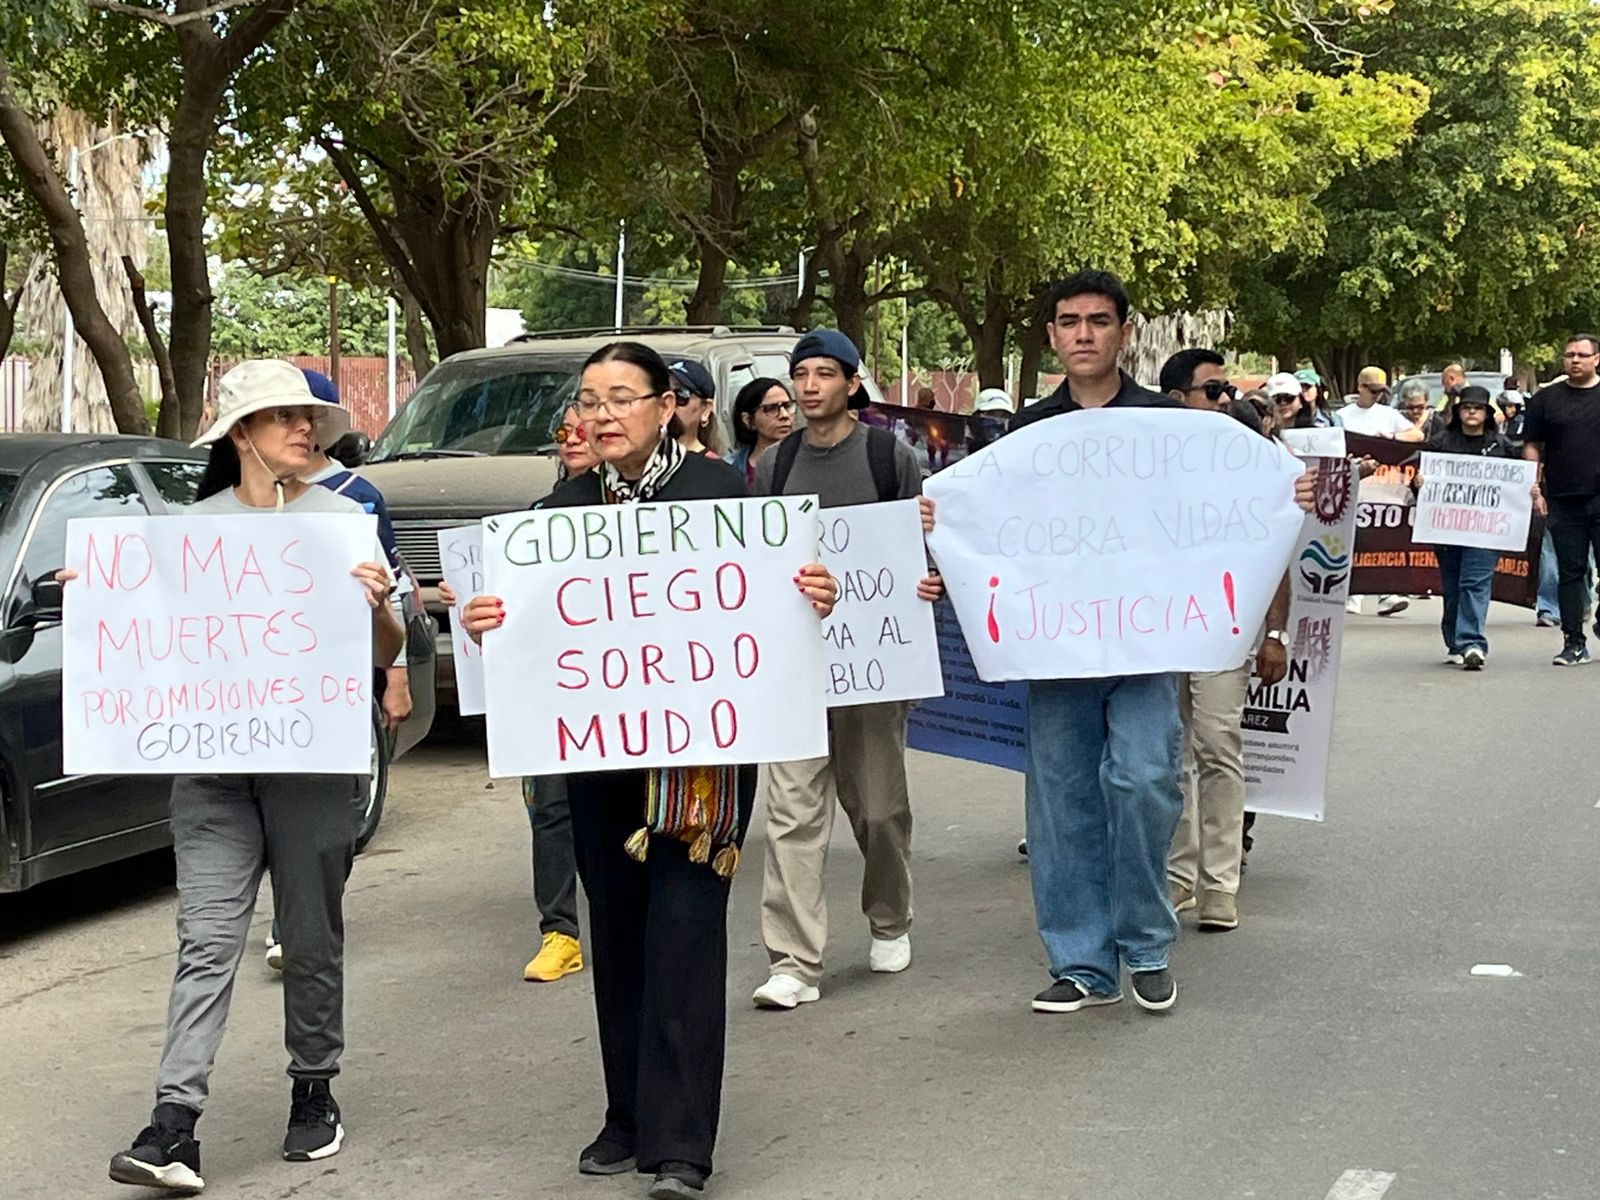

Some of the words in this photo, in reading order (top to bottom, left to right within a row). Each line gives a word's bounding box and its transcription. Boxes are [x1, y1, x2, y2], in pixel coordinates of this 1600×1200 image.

[949, 450, 1003, 480] LA
[1031, 432, 1282, 480] CORRUPCION
[997, 516, 1128, 559] COBRA
[1153, 496, 1270, 549] VIDAS
[1356, 503, 1402, 528] STO
[86, 533, 153, 592] NO
[182, 534, 315, 601] MAS
[1408, 552, 1440, 569] TIEN
[556, 562, 747, 627] CIEGO
[97, 609, 318, 674] MUERTES
[878, 616, 913, 646] AL
[556, 632, 760, 690] SORDO
[826, 658, 885, 695] BLO
[81, 687, 140, 729] POR
[145, 676, 306, 721] OMISIONES
[1243, 714, 1269, 727] REZ
[136, 708, 314, 761] GOBIERNO
[556, 698, 738, 762] MUDO
